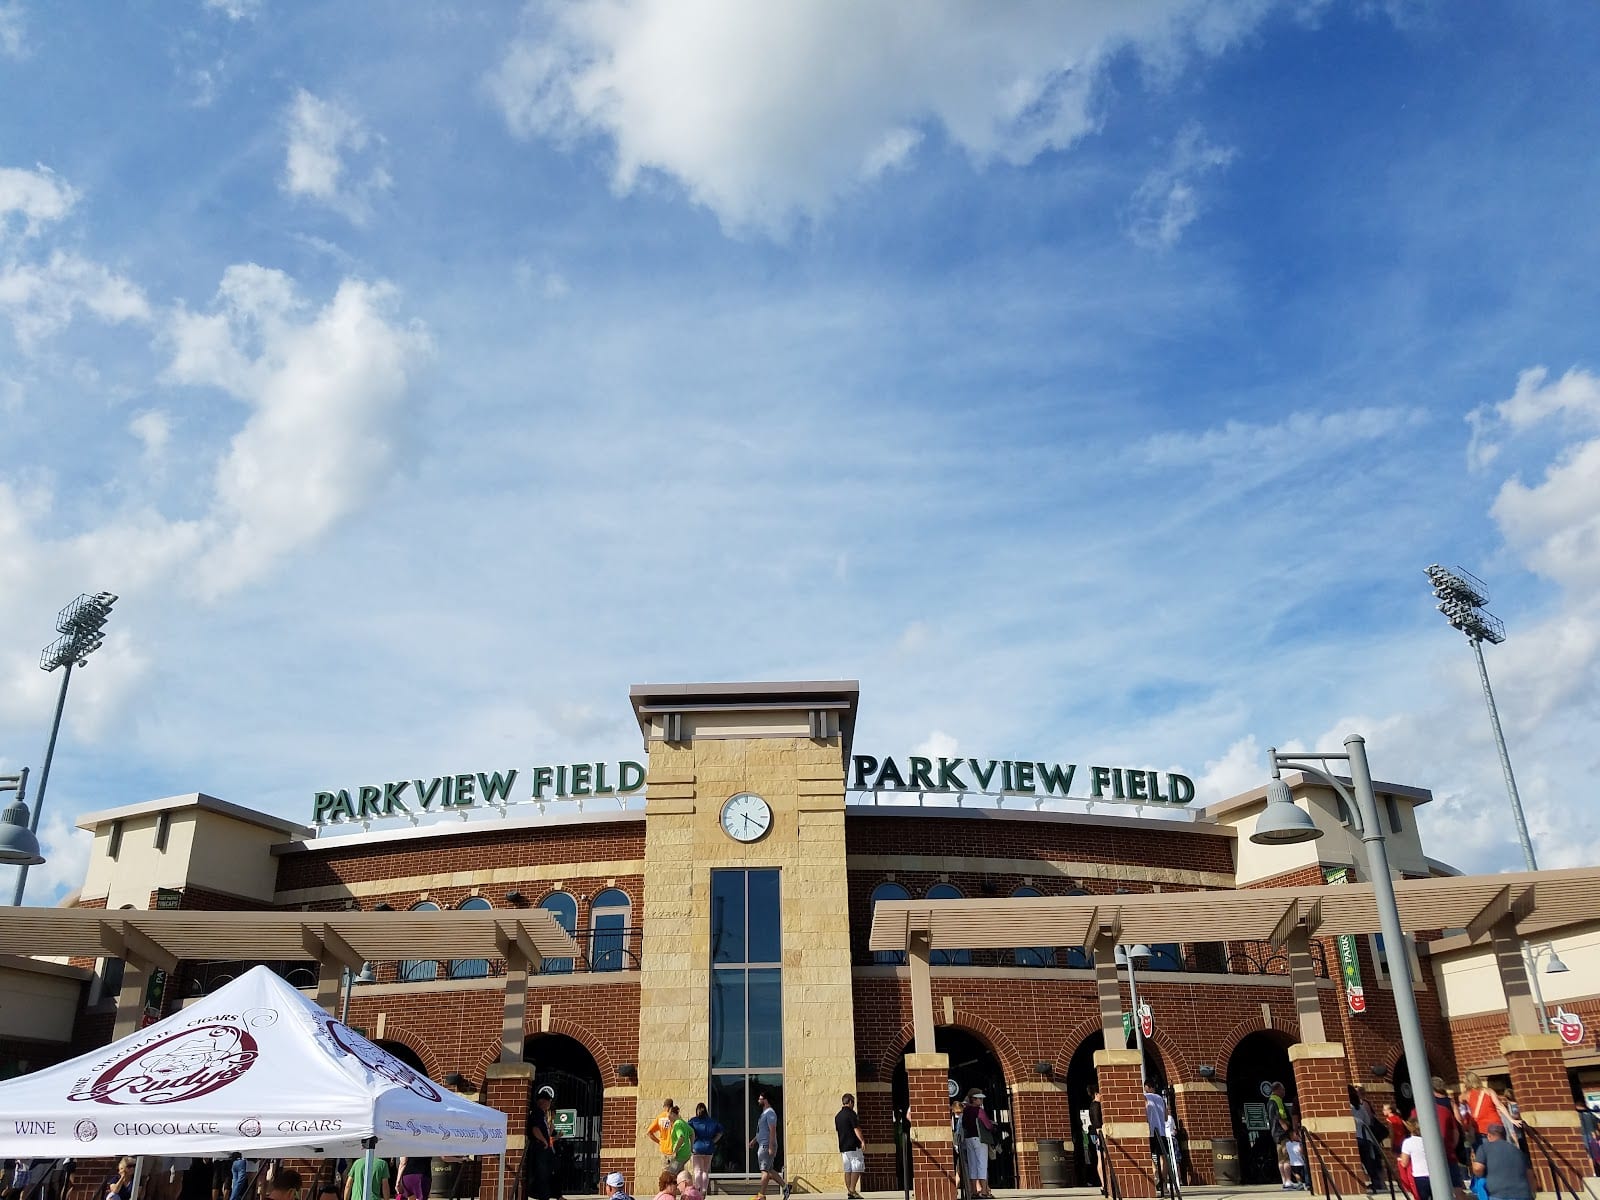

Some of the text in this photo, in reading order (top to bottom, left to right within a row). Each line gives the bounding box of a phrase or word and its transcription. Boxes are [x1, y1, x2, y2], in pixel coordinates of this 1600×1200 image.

[312, 760, 647, 825] PARKVIEW FIELD
[852, 754, 1196, 804] PARKVIEW FIELD
[92, 1030, 173, 1072] CHOCOLATE
[187, 1014, 239, 1027] CIGARS
[68, 1051, 259, 1103] Rudy's
[14, 1120, 57, 1135] WINE
[113, 1121, 219, 1136] CHOCOLATE
[277, 1118, 342, 1133] CIGARS
